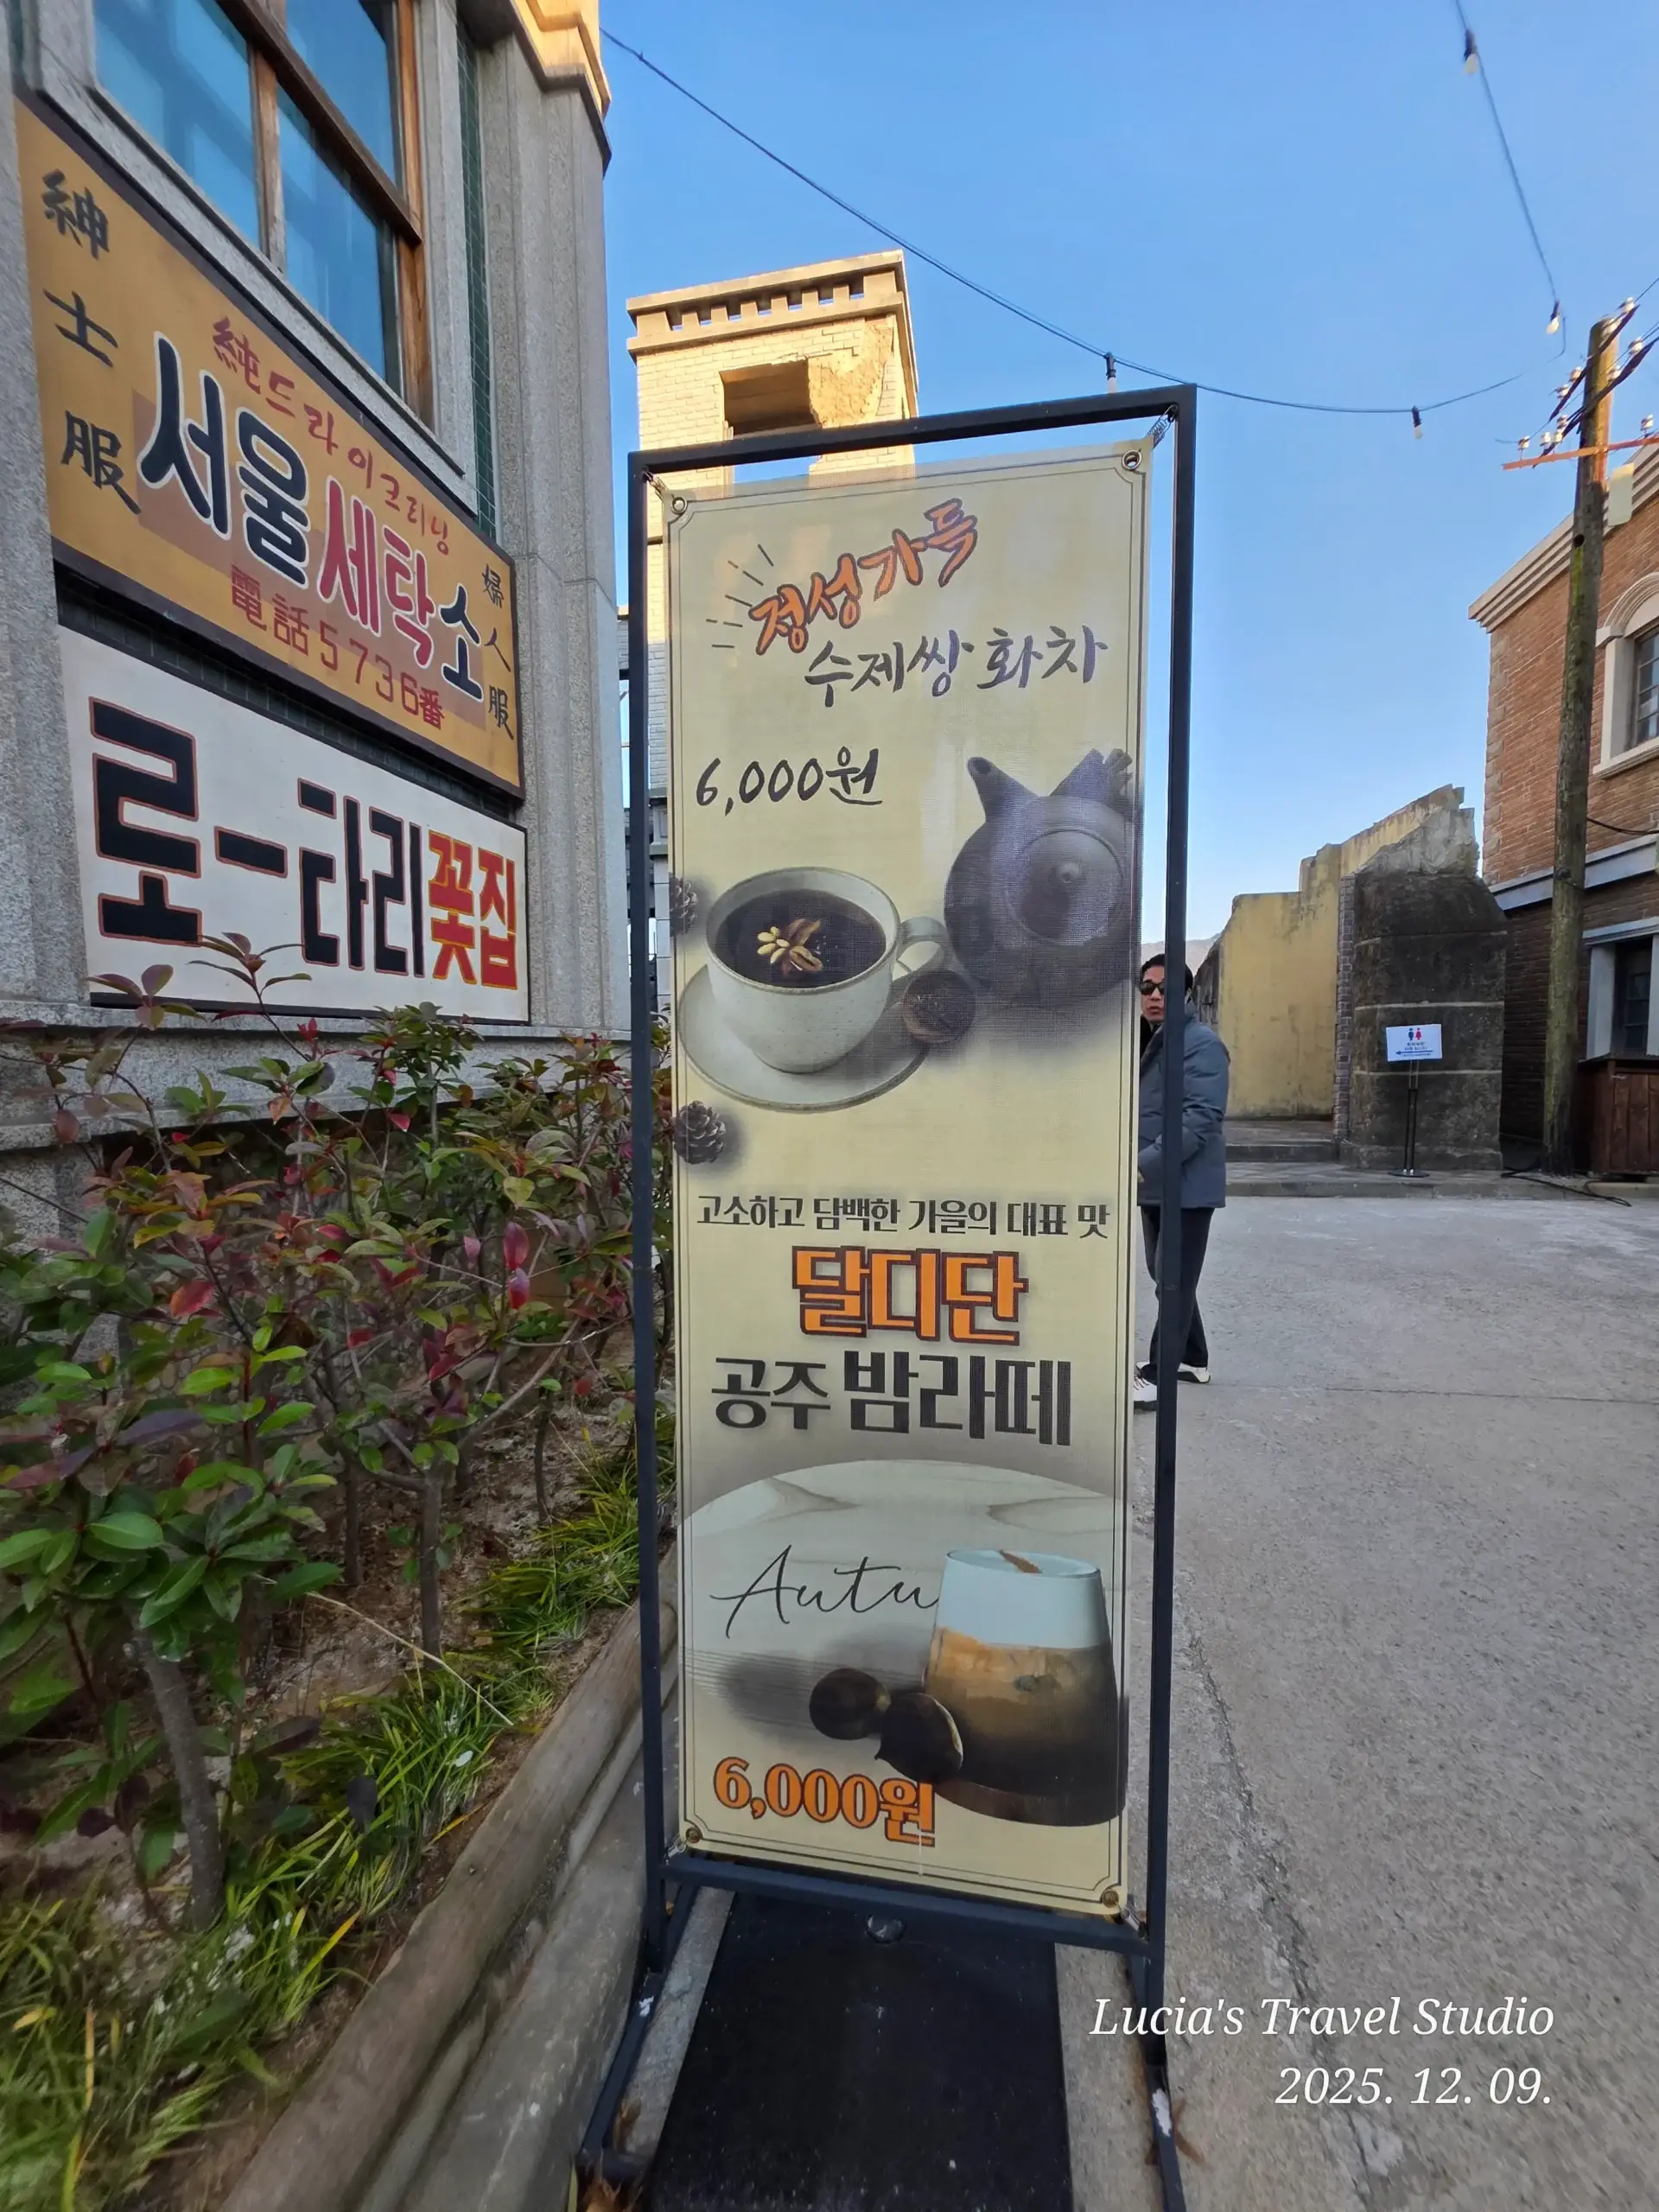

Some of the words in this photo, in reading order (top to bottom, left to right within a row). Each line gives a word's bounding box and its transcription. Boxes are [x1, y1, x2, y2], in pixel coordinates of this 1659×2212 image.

[41, 168, 142, 515] 紳士服
[696, 746, 883, 816] 6,000원
[696, 1195, 805, 1229] 고소하고
[813, 1198, 900, 1233] 담백한
[908, 1198, 997, 1236] 가을의
[1007, 1202, 1069, 1236] 대표
[1077, 1204, 1110, 1240] 맛
[791, 1245, 1029, 1345] 달디단
[714, 1756, 936, 1848] 6,000원
